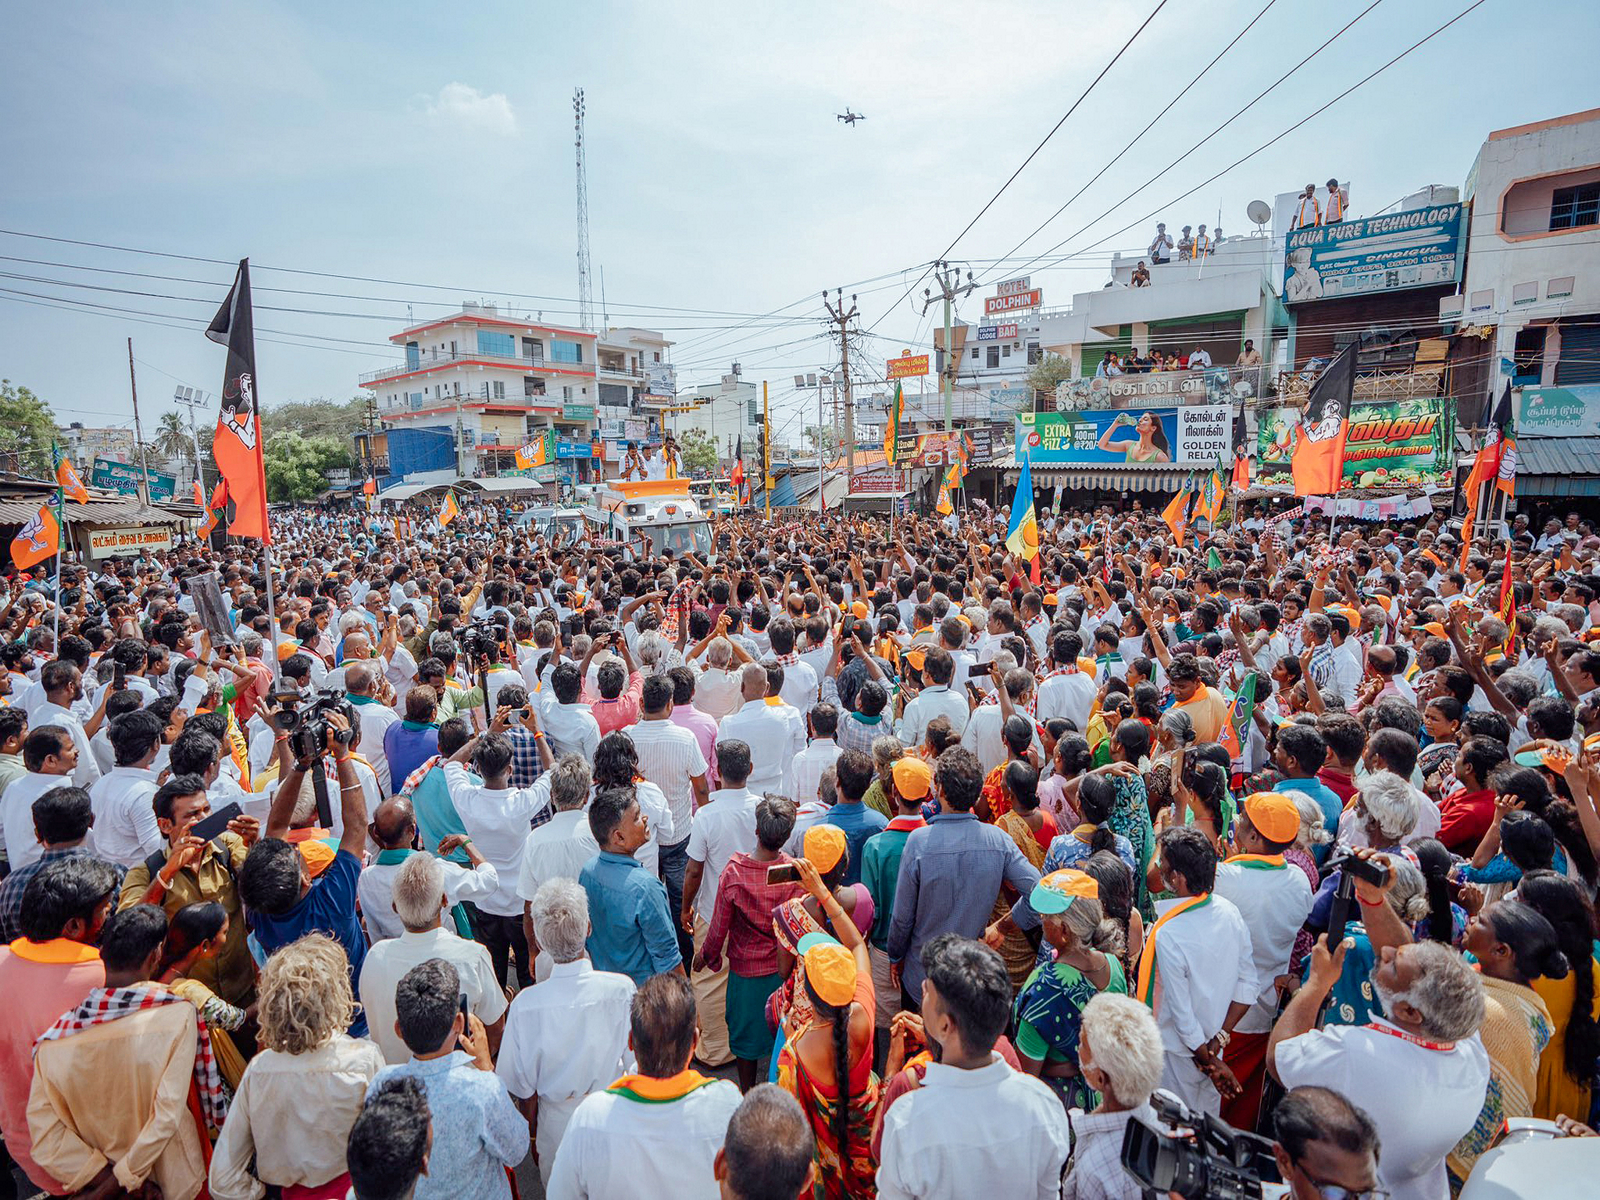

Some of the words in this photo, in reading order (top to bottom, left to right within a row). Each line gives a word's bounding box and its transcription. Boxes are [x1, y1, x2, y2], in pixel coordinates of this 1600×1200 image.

[1289, 230, 1324, 247] AQUA
[1328, 222, 1363, 241] PURE
[1367, 206, 1459, 234] TECHNOLOGY
[997, 279, 1028, 295] HOTEL
[989, 293, 1031, 311] DOLPHIN
[998, 326, 1016, 337] BAR
[1110, 374, 1204, 397] கோல்டன்
[1184, 409, 1226, 423] கோல்டன்
[1044, 424, 1071, 437] EXTRA
[1185, 424, 1224, 437] ரிலாக்ஸ்
[1043, 438, 1062, 450] FIZZ
[1183, 441, 1226, 450] GOLDEN
[1188, 451, 1220, 460] RELAX
[92, 531, 117, 549] லட்சுமி
[119, 534, 137, 547] சைவ
